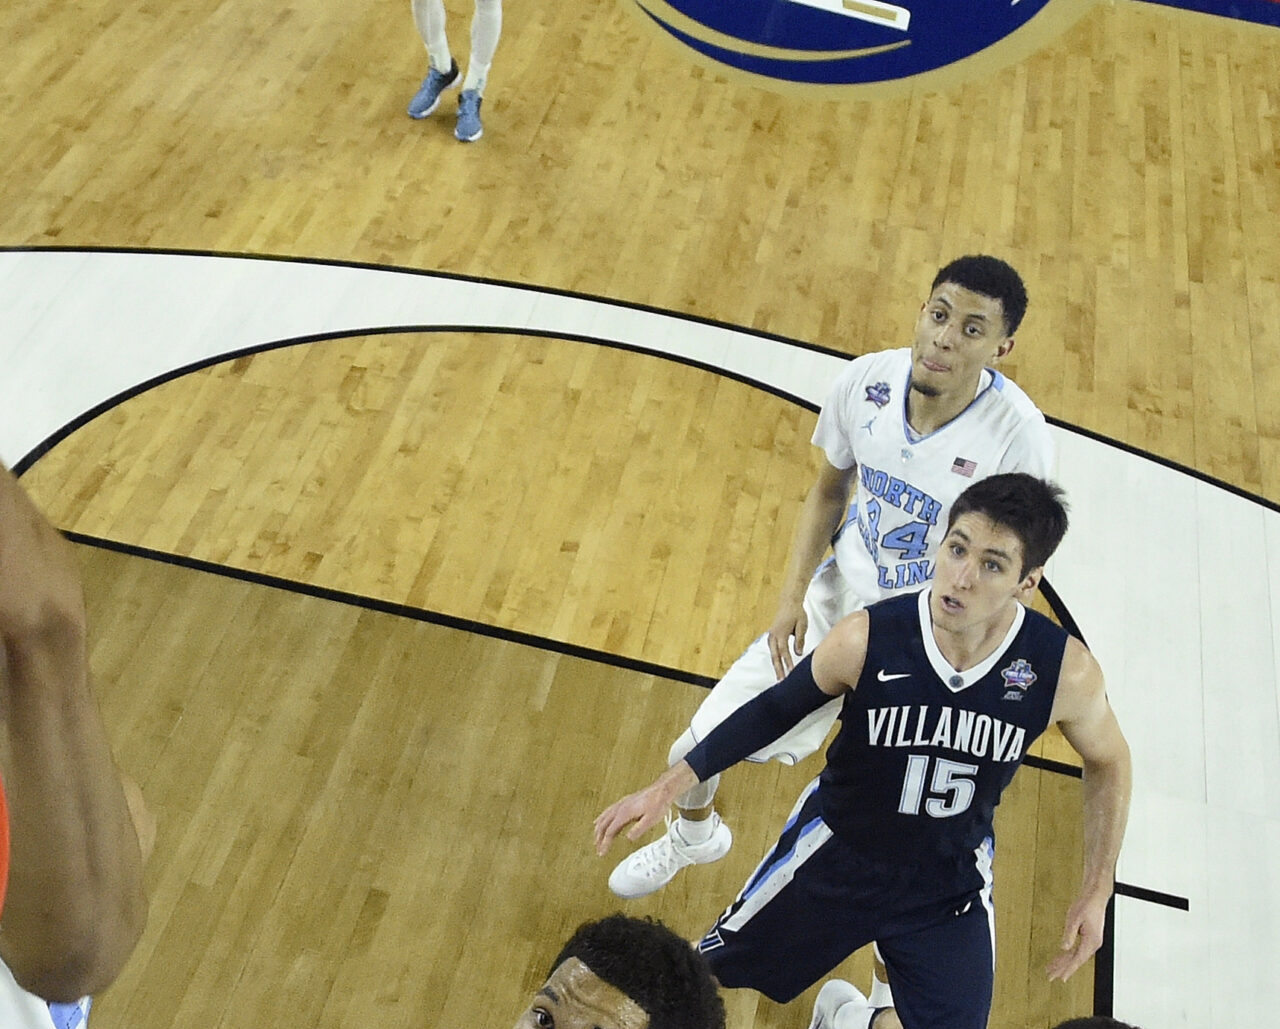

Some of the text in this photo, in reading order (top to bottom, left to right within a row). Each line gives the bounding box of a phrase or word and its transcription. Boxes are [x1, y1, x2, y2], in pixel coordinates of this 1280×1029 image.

[860, 464, 943, 526] NORTH
[867, 705, 1026, 763] VILLANOVA
[898, 754, 979, 818] 15
